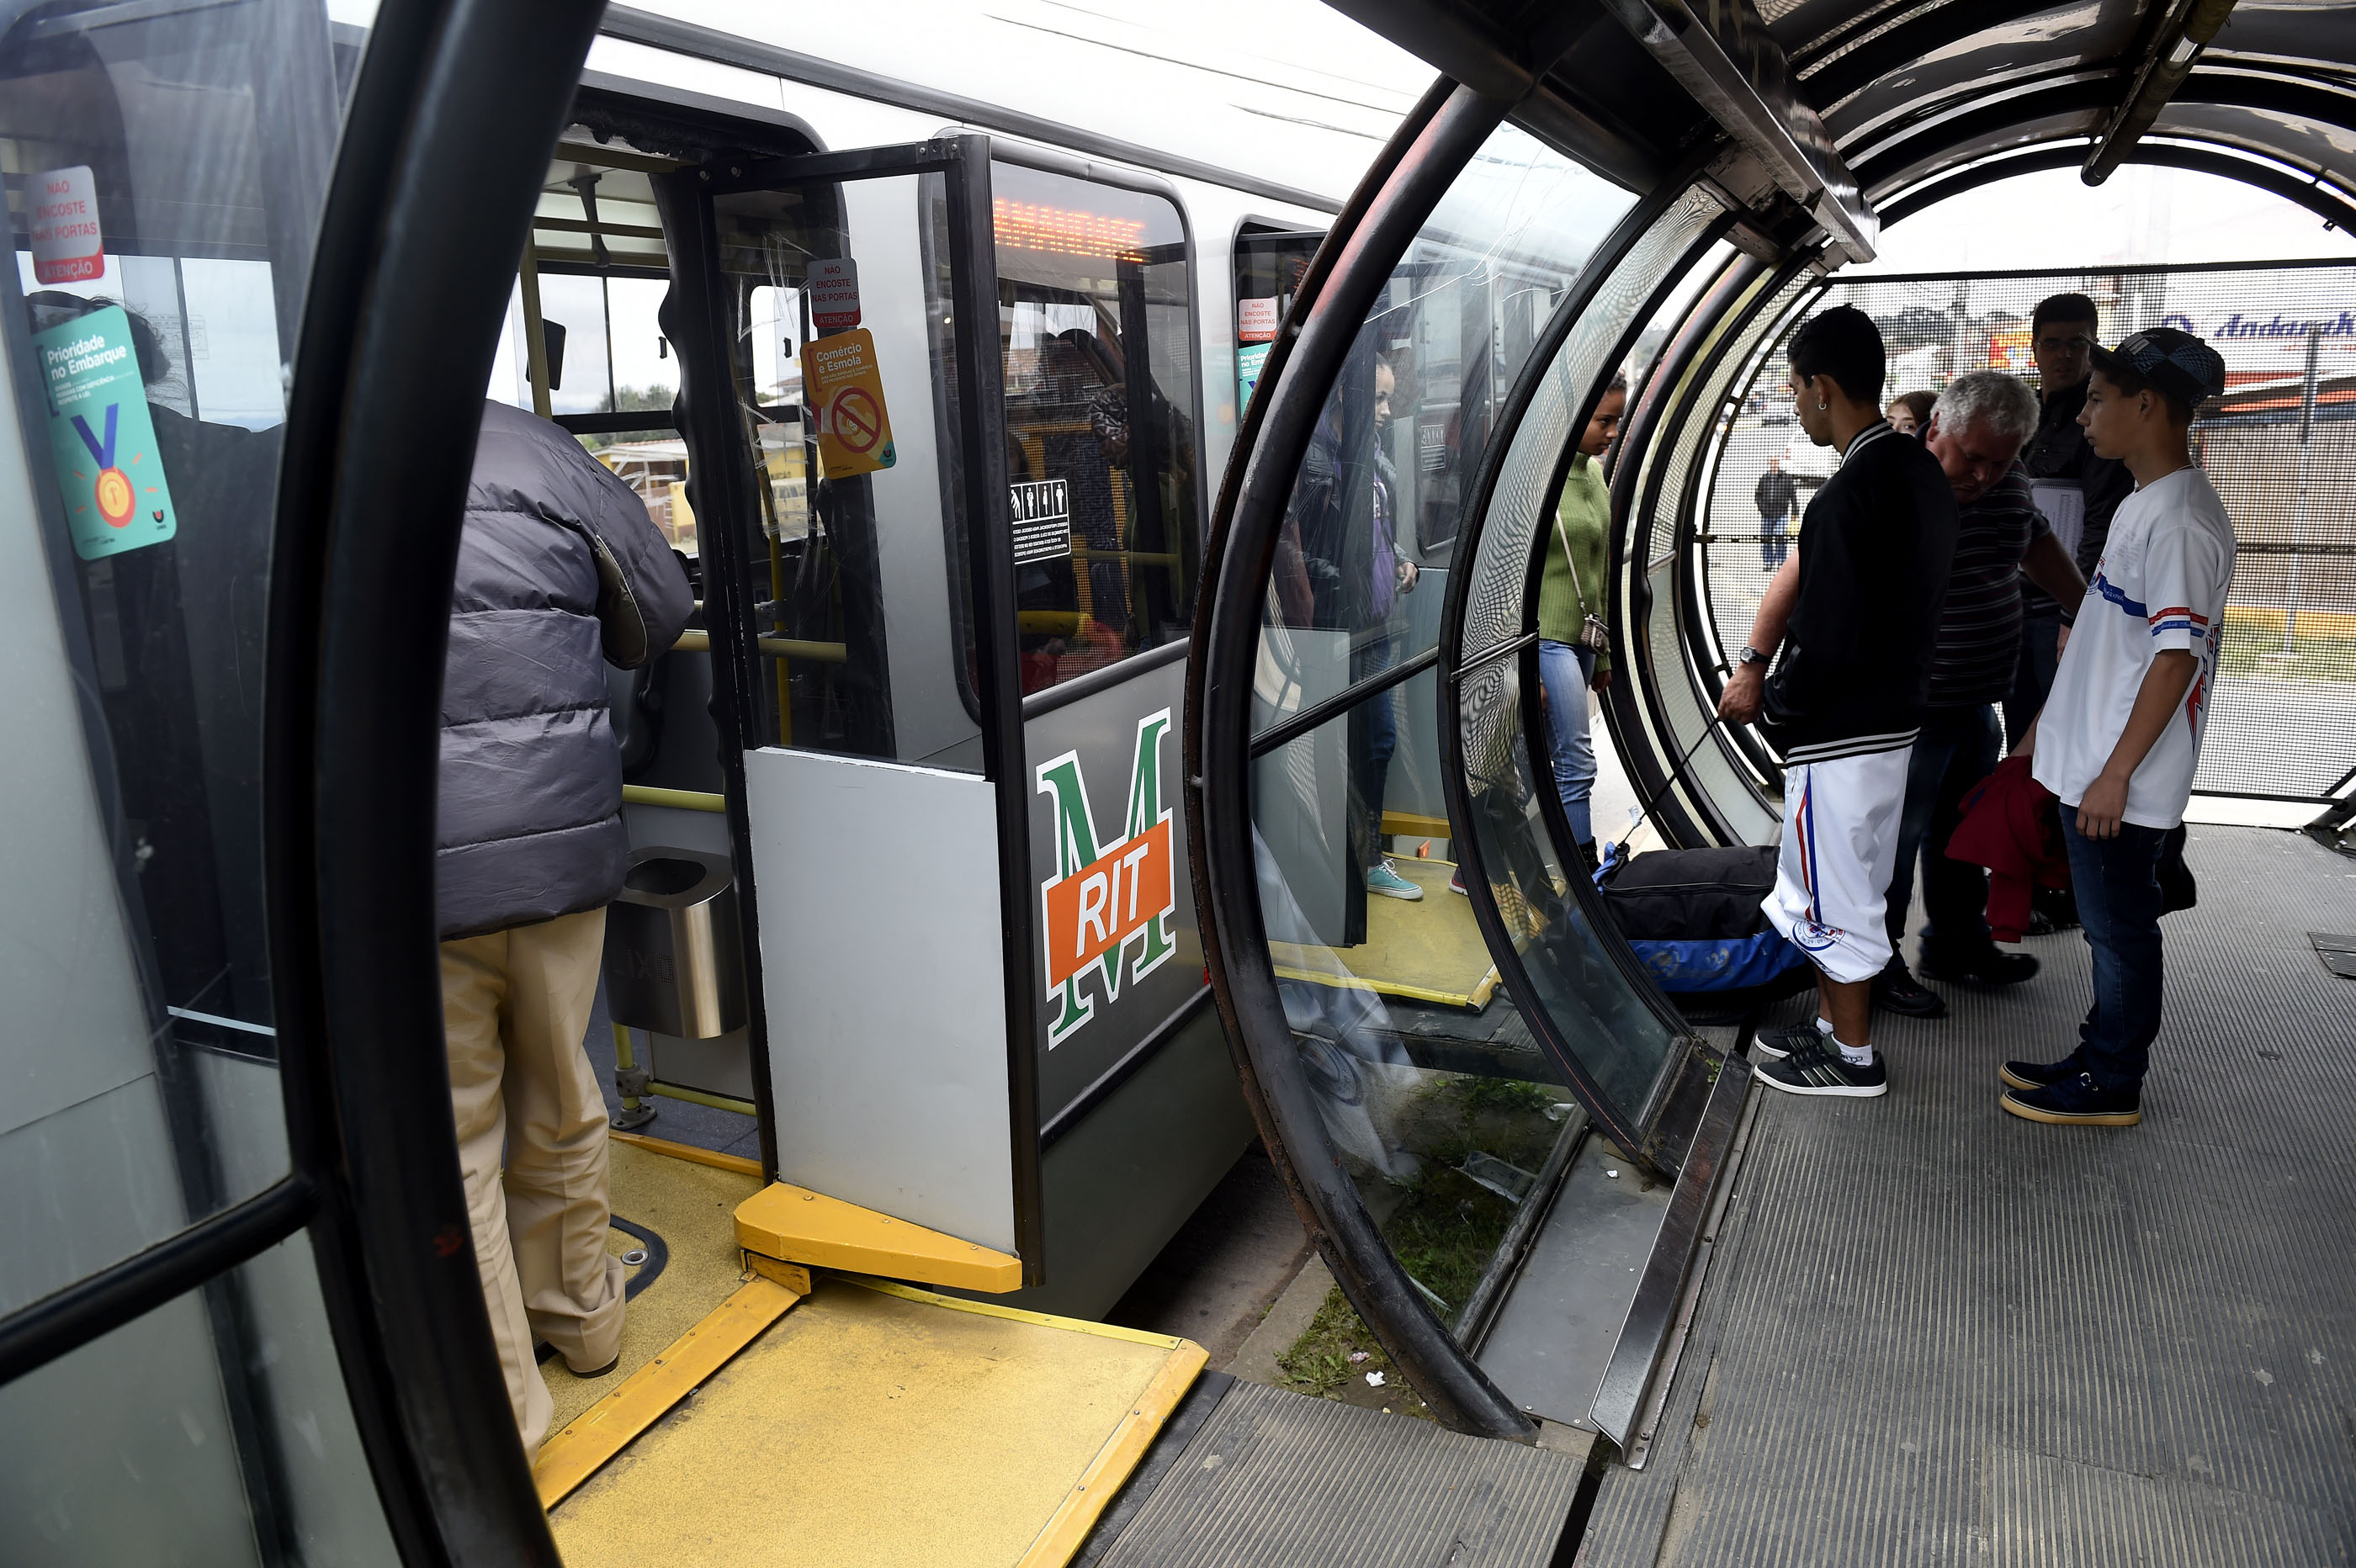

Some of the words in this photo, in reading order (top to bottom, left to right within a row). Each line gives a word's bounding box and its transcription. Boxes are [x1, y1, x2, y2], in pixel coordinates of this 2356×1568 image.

[47, 178, 70, 195] NÃO
[37, 200, 87, 219] ENCOSTE
[55, 221, 97, 240] PORTAS
[45, 259, 93, 278] ATENÇÃO
[825, 265, 841, 275] NÃO
[816, 278, 852, 289] ENCOSTE
[812, 294, 827, 303] NAS
[828, 291, 858, 301] PORTAS
[820, 314, 853, 325] ATENÇÃO
[47, 334, 105, 365] Prioridade
[816, 343, 862, 363] Comércio
[51, 366, 66, 380] no
[68, 345, 126, 375] Embarque
[819, 365, 825, 373] e
[826, 355, 862, 373] Esmola
[1076, 842, 1149, 959] RIT
